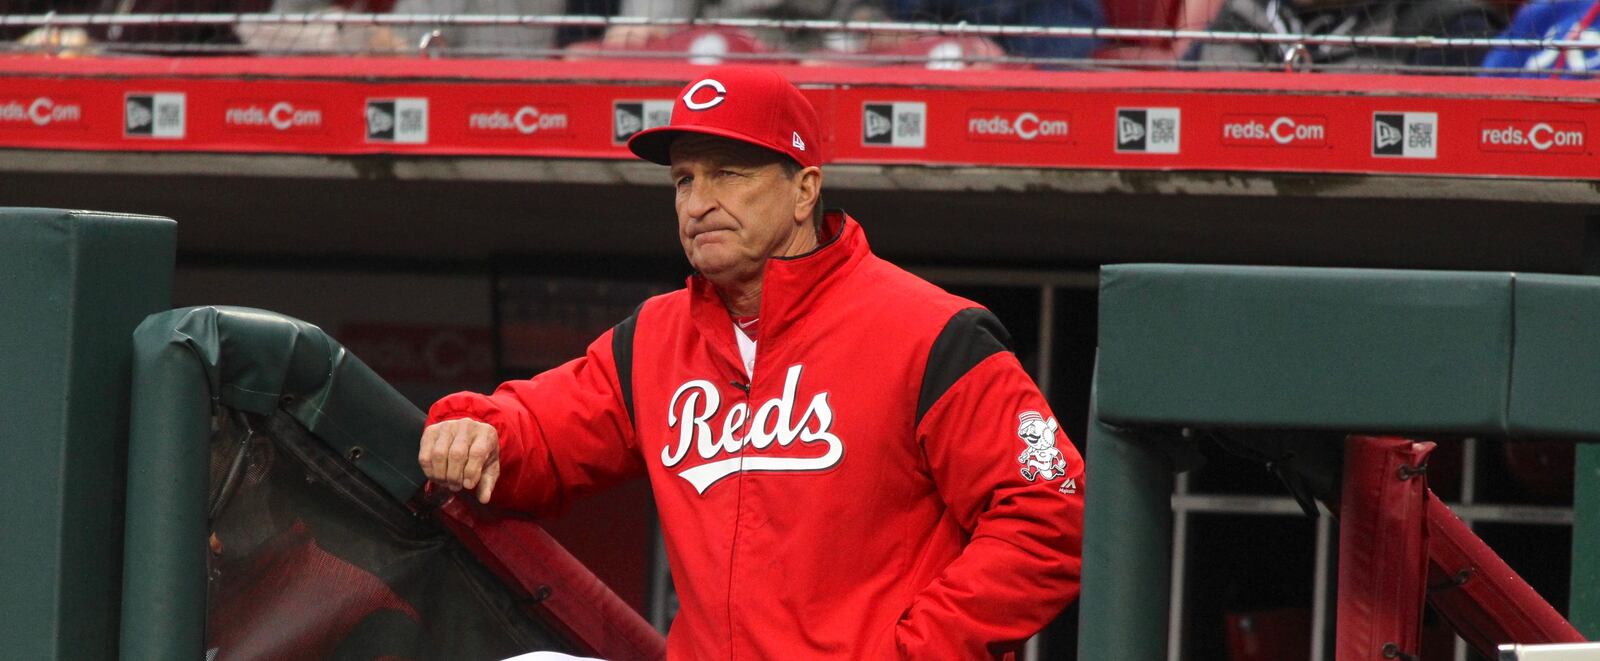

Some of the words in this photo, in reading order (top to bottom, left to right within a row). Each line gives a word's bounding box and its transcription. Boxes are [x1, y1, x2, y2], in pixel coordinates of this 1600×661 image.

[682, 78, 727, 111] C
[469, 106, 568, 134] reds.Com
[968, 111, 1068, 140] reds.Com
[1223, 116, 1325, 145] reds.Com
[1409, 123, 1433, 135] NEW
[1408, 135, 1432, 148] ERA
[1481, 122, 1583, 151] reds.Com
[660, 364, 844, 495] Reds
